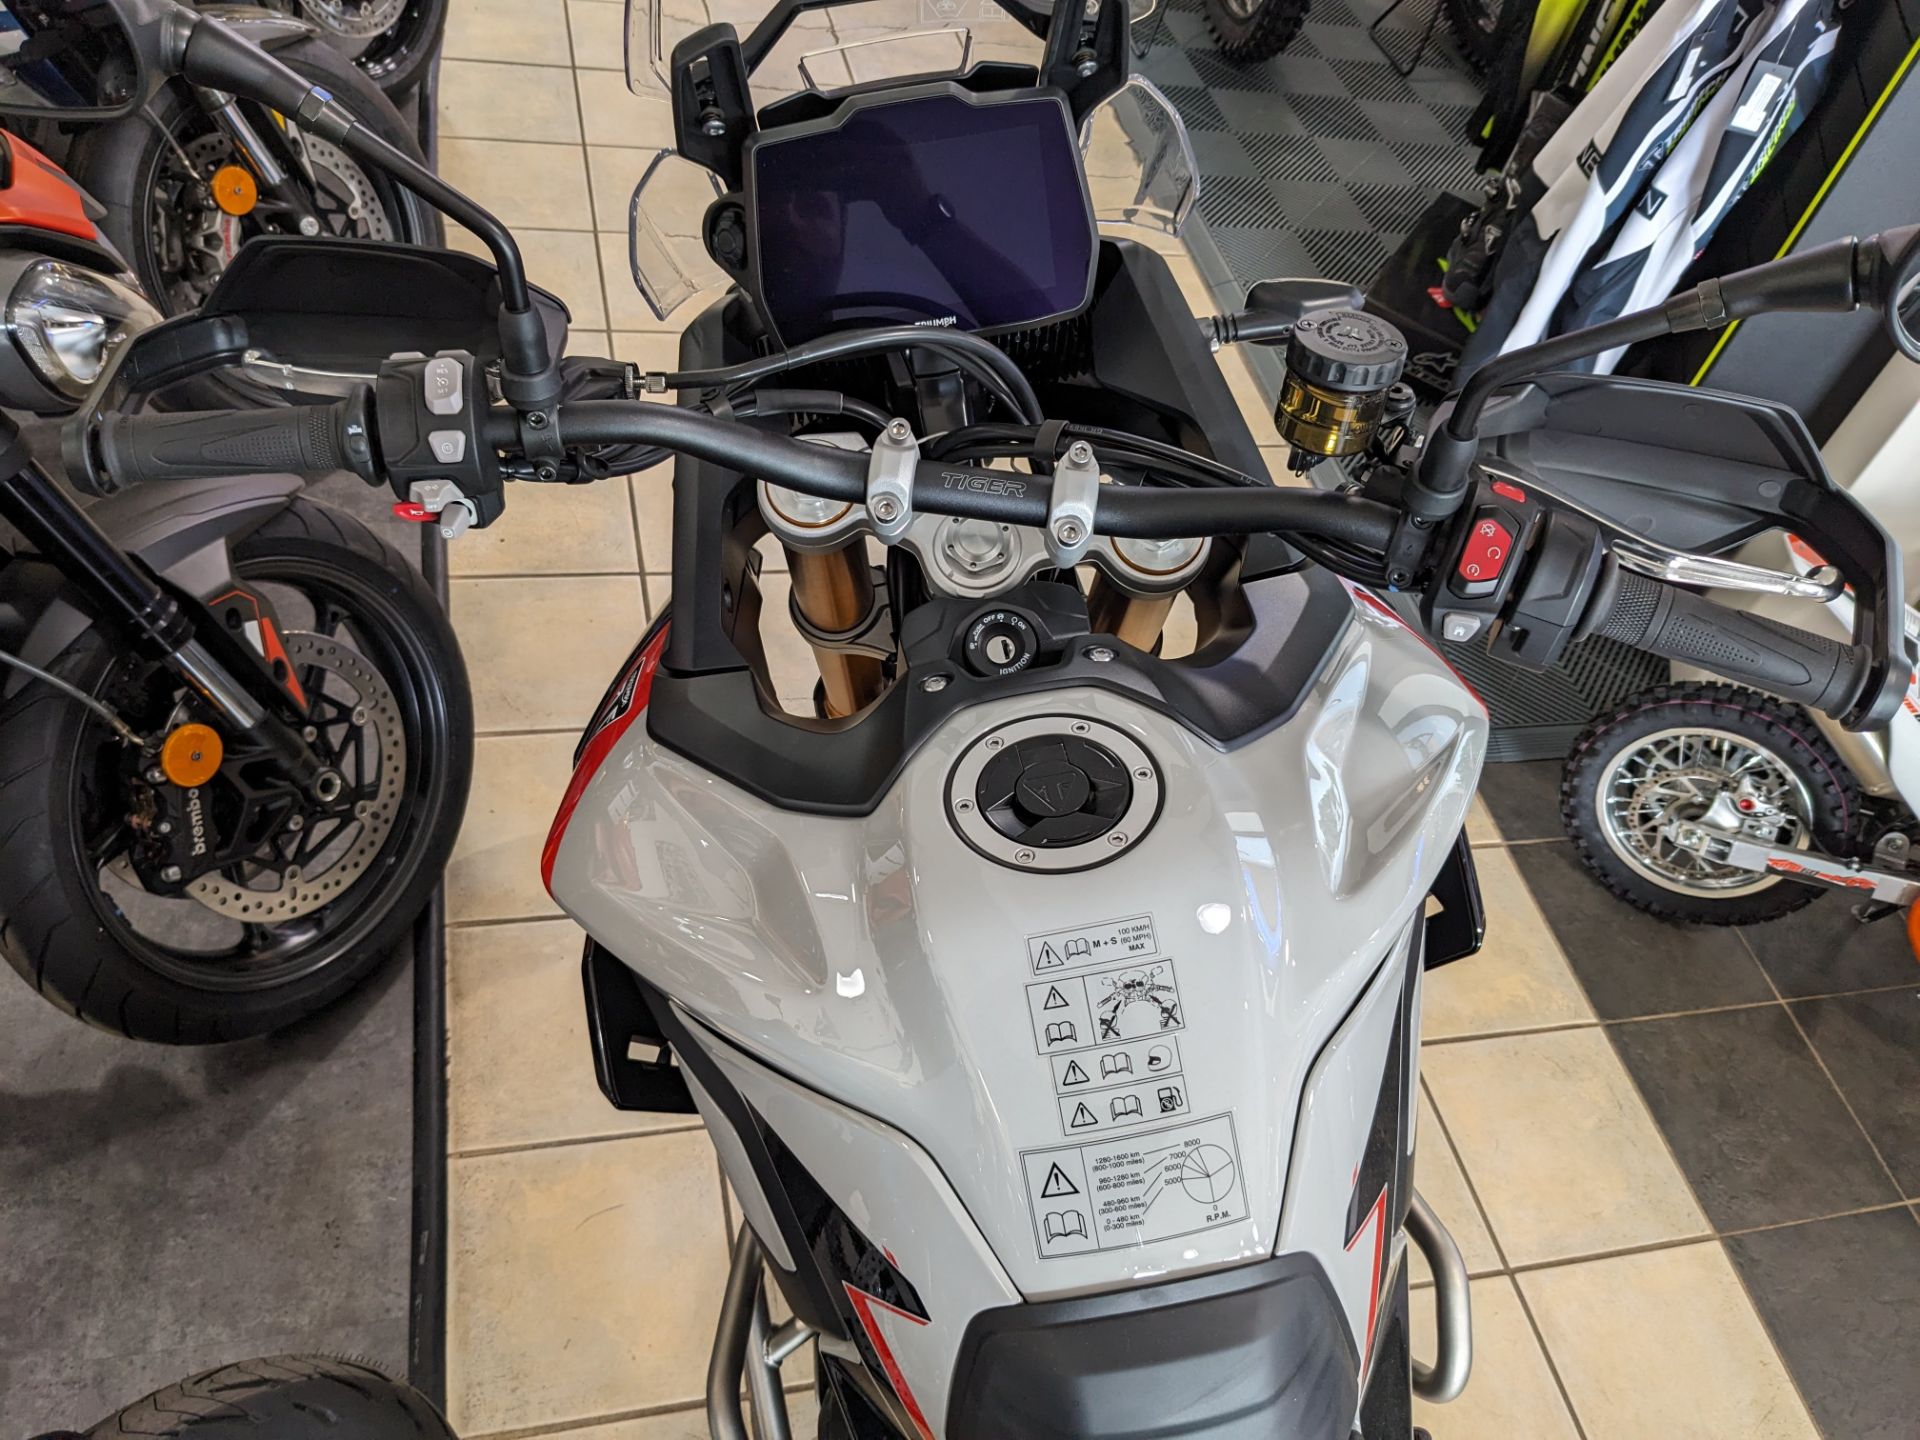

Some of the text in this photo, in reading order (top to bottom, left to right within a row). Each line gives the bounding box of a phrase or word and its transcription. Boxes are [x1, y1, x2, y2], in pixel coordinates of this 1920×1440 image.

[941, 472, 1027, 498] TIGER
[983, 614, 996, 624] OFF
[1017, 621, 1027, 630] ON
[999, 652, 1031, 676] IGNITION
[186, 788, 206, 856] brembo
[1118, 924, 1150, 935] 100 KM/H
[1092, 939, 1101, 948] M
[1110, 936, 1118, 945] S
[1120, 932, 1152, 944] (60 MPH)
[1128, 942, 1145, 951] MAX
[1183, 1137, 1201, 1148] 8000
[1095, 1153, 1129, 1164] 1280-1600
[1169, 1150, 1187, 1160] 7000
[1164, 1162, 1182, 1172] 6000
[1098, 1173, 1130, 1184] 960-1280
[1164, 1176, 1182, 1186] 5000
[1096, 1181, 1126, 1193] (600-800
[1103, 1197, 1130, 1207] 480-960
[1098, 1204, 1127, 1216] (300-600
[1206, 1210, 1231, 1222] R.P.M.
[1103, 1222, 1125, 1233] (0-300
